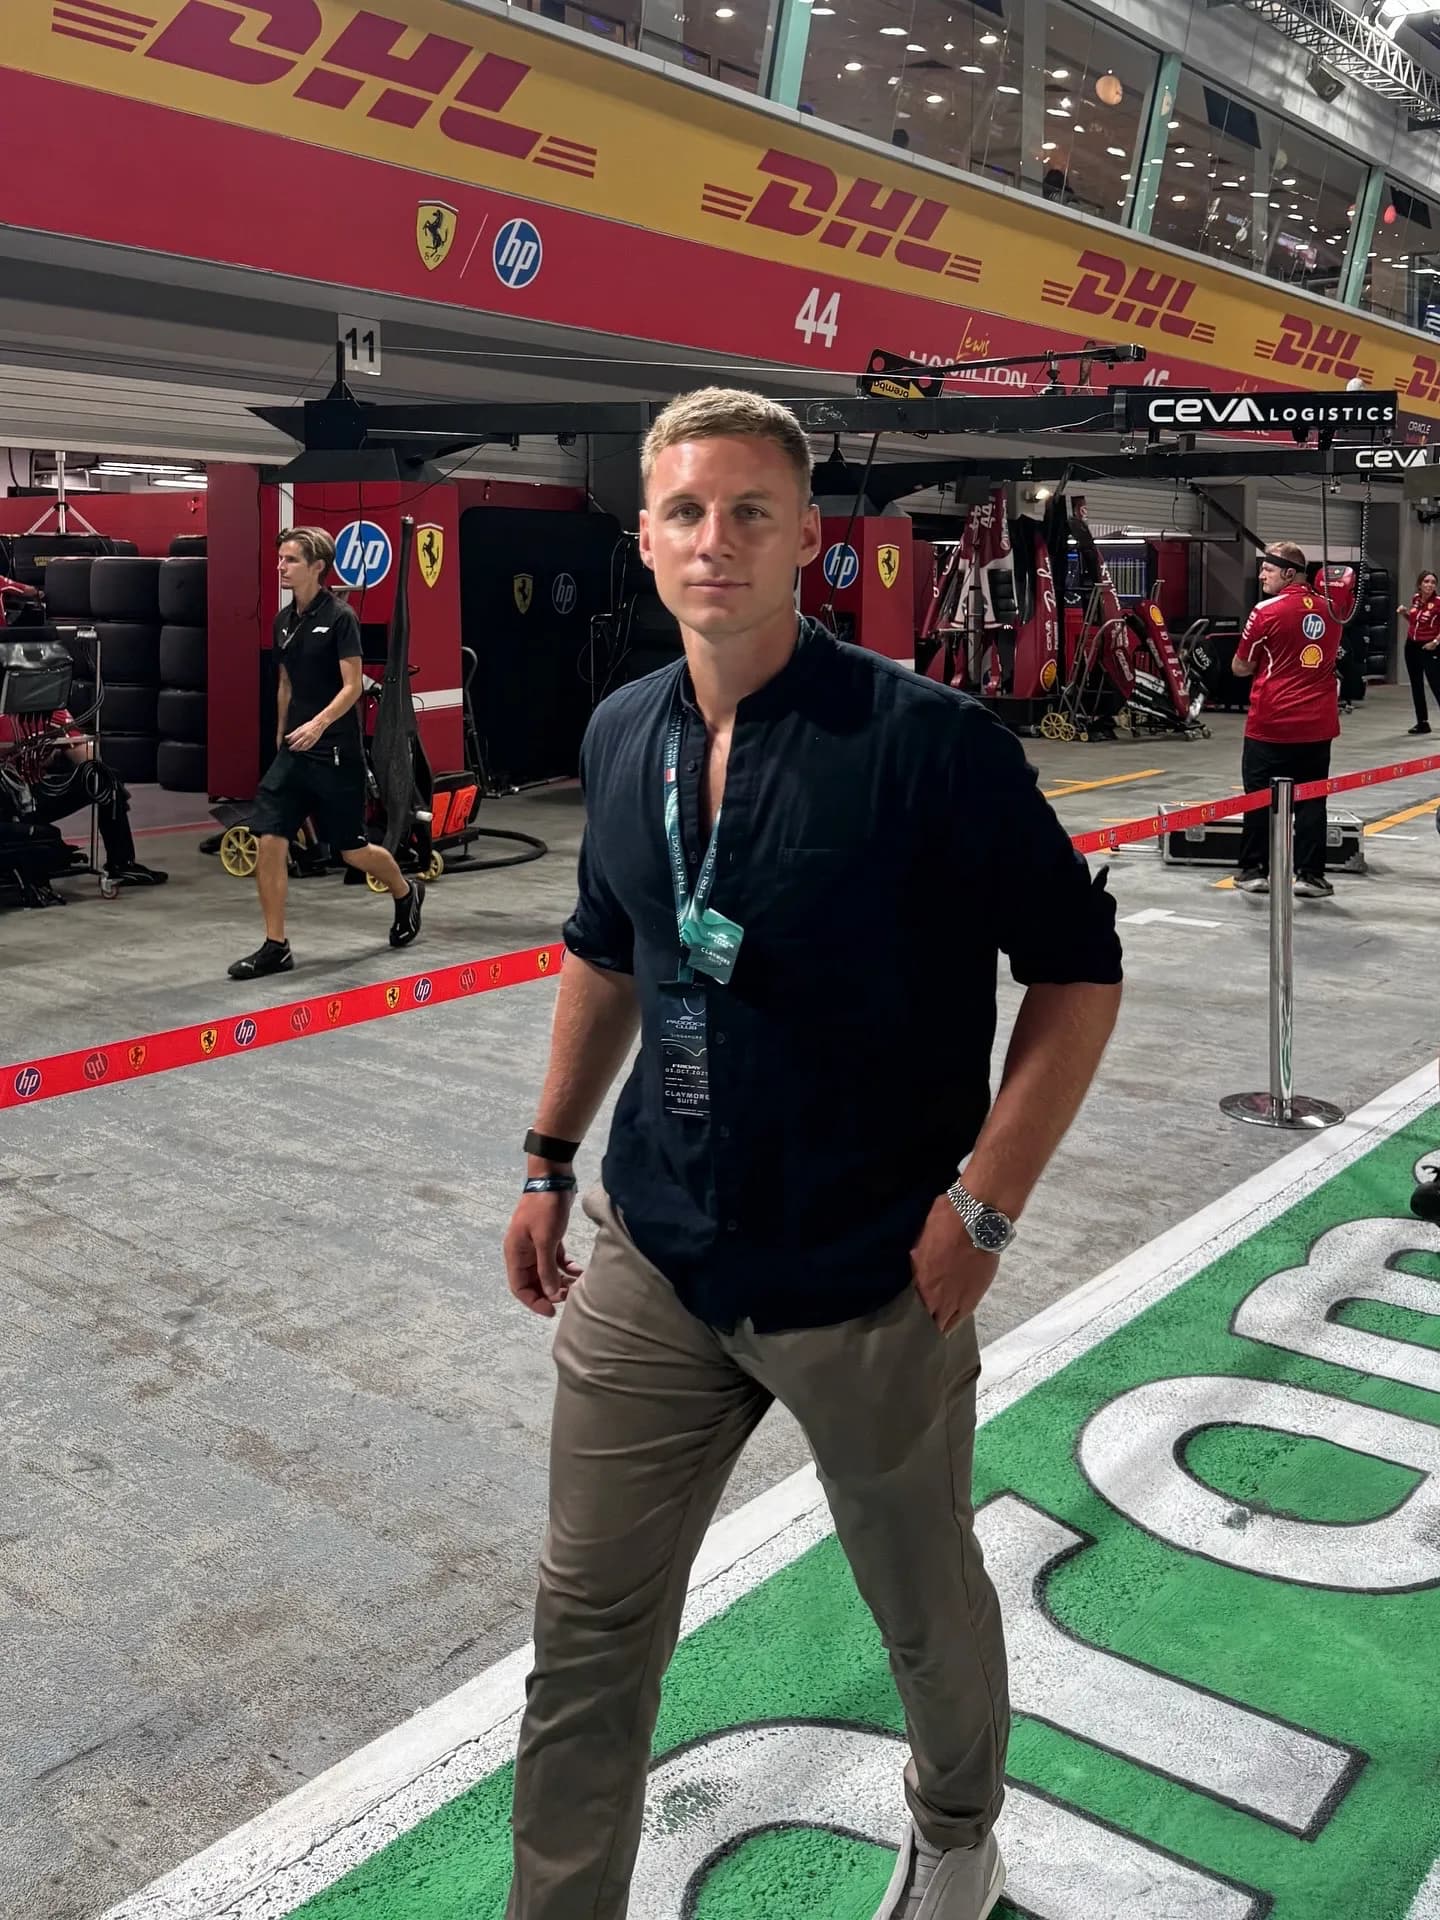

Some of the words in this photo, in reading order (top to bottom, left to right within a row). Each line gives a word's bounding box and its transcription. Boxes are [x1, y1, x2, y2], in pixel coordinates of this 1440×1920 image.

[144, 0, 542, 160] DHL
[745, 148, 954, 275] DHL
[498, 220, 538, 285] hp
[1065, 249, 1198, 340] DHL
[794, 287, 839, 348] 44
[346, 328, 374, 362] 11
[956, 317, 991, 360] Lewis
[1271, 313, 1358, 380] DHL
[1269, 406, 1394, 422] LOGISTICS
[340, 522, 385, 586] hp
[828, 544, 855, 588] hp
[556, 574, 574, 613] hp
[1305, 614, 1322, 639] hp
[677, 871, 687, 894] FRI
[697, 876, 709, 899] FRI
[415, 978, 431, 1002] hp
[237, 1018, 255, 1046] hp
[18, 1066, 40, 1097] hp
[665, 1090, 710, 1101] CLAYMORE
